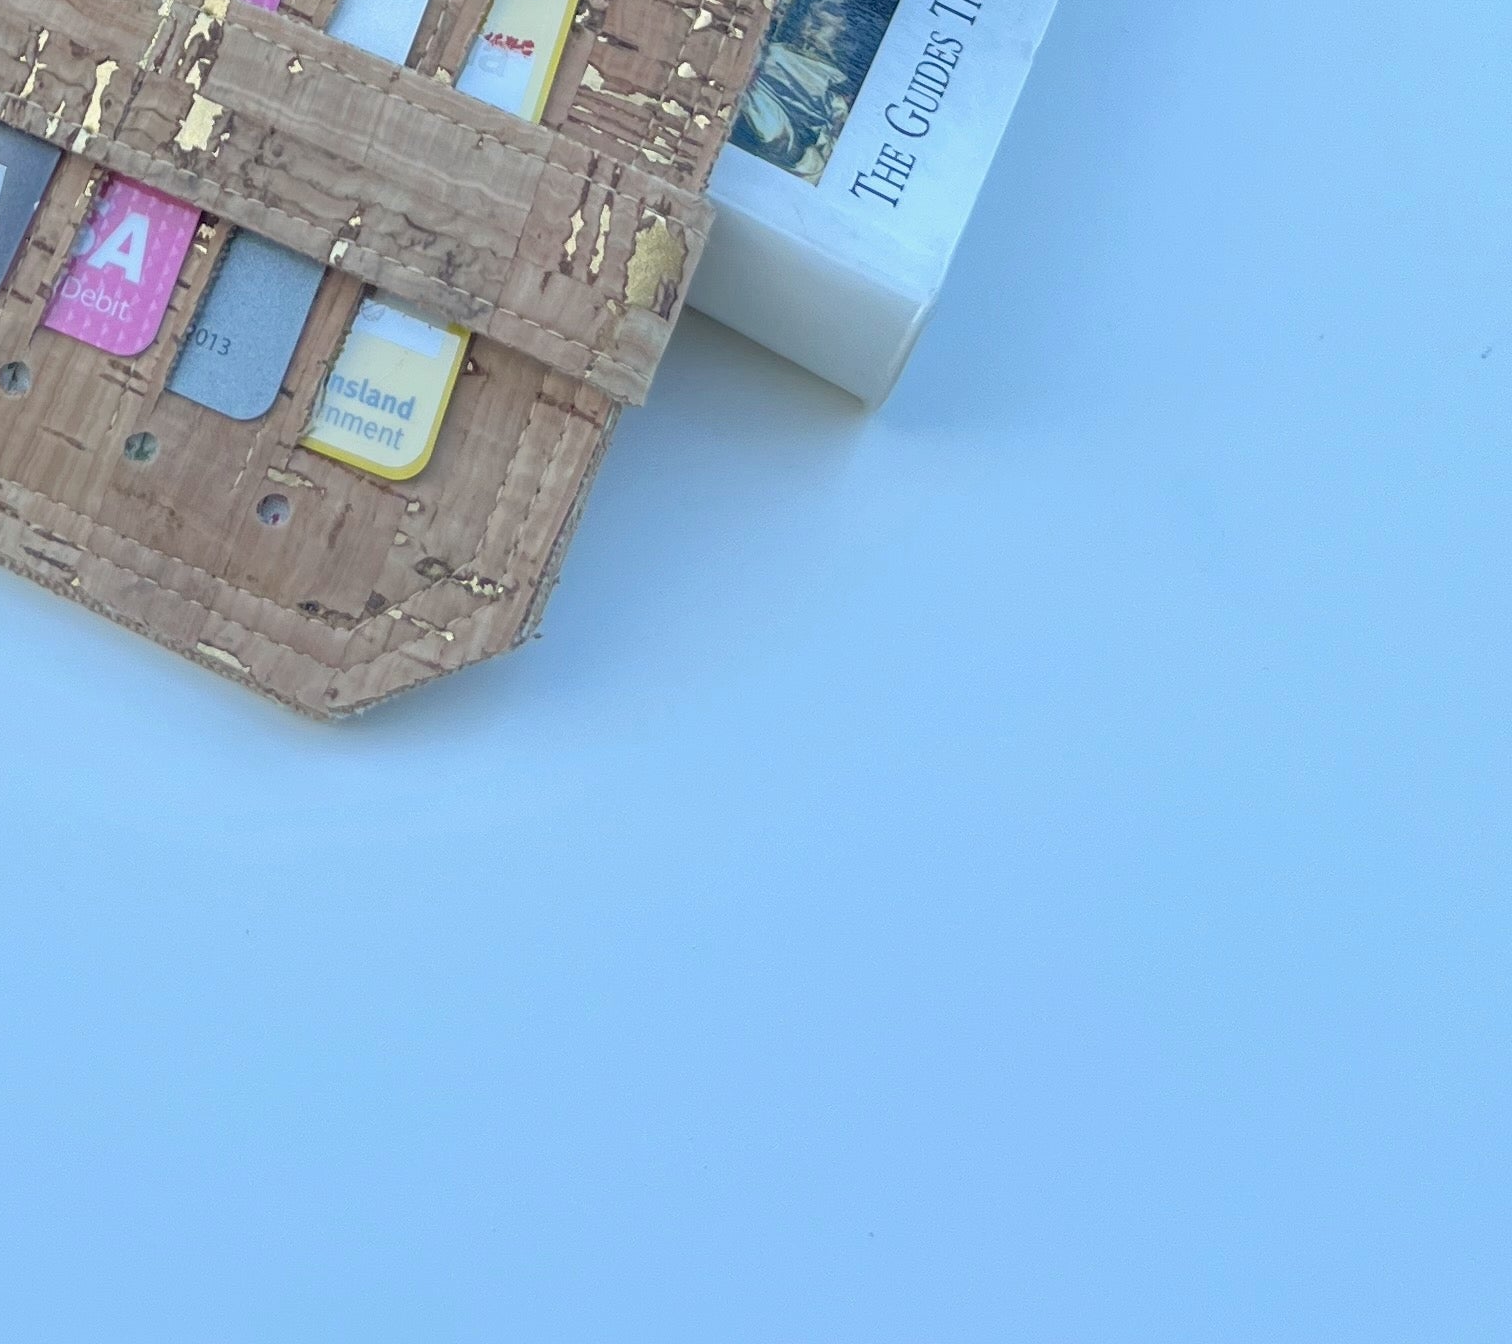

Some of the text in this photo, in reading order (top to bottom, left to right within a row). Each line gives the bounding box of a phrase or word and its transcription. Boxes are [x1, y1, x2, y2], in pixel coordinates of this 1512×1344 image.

[849, 143, 917, 208] THE
[885, 31, 964, 139] GUIDES
[60, 275, 131, 321] Debit
